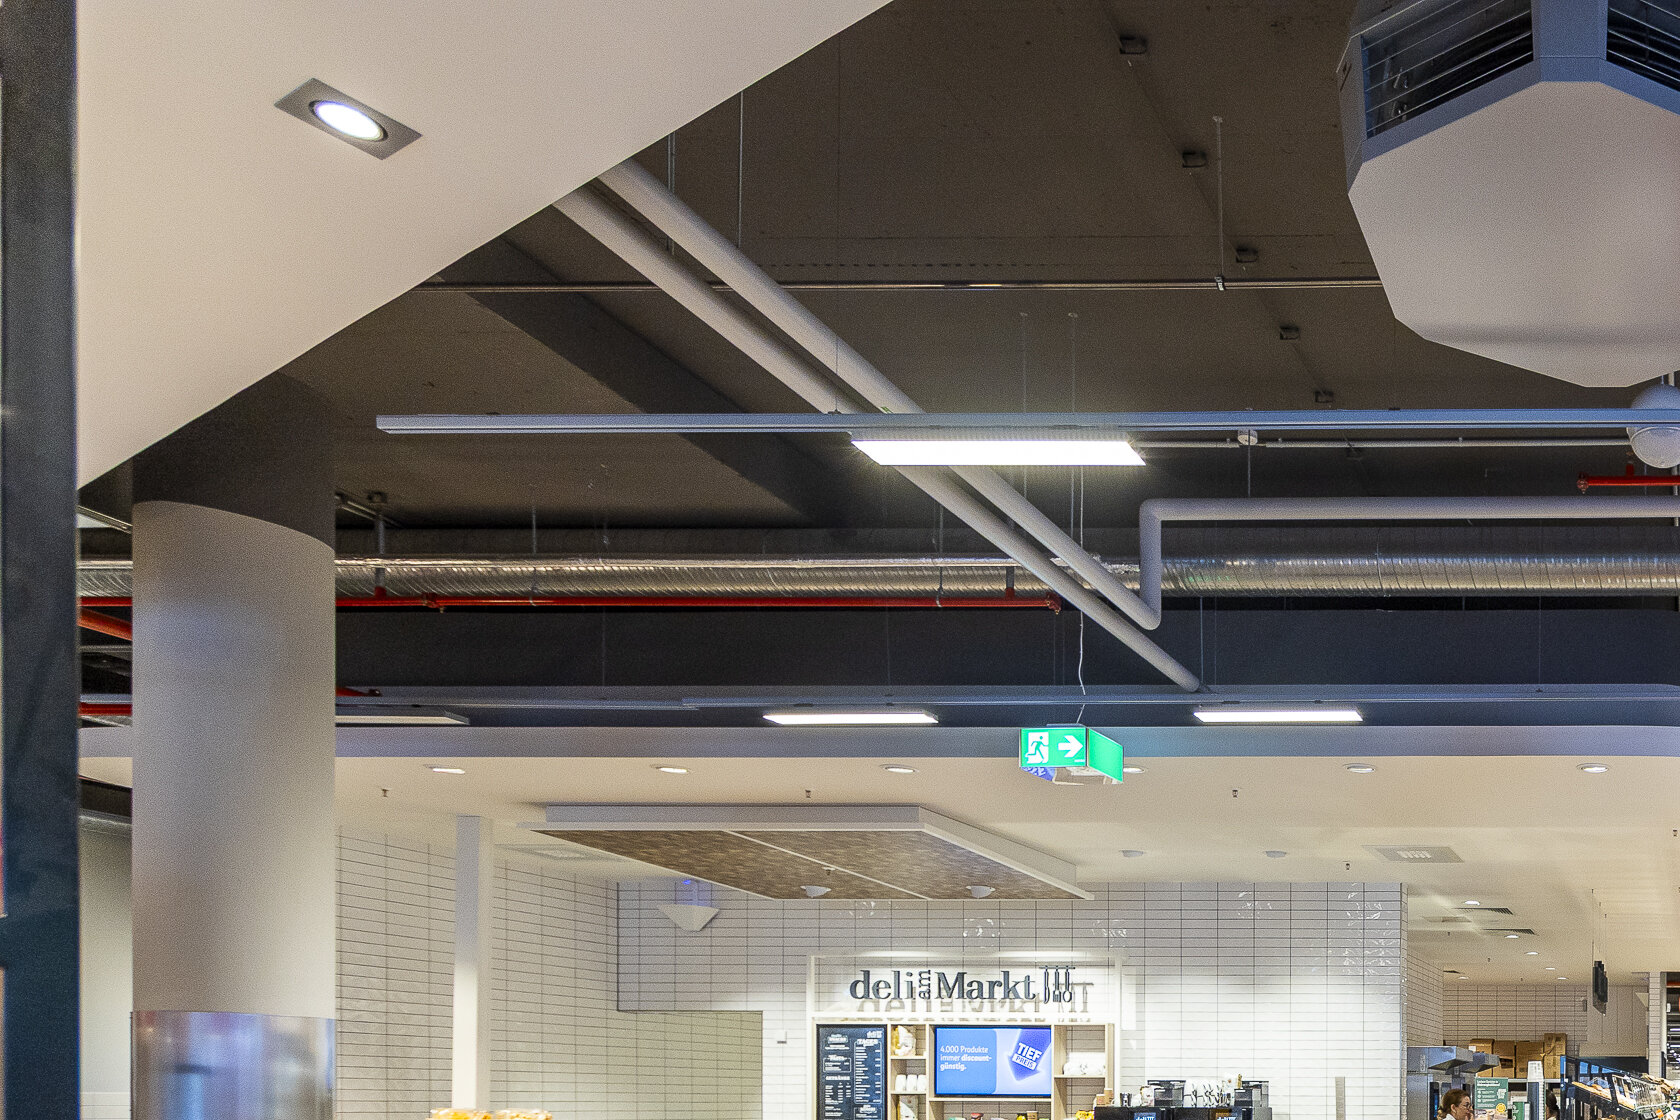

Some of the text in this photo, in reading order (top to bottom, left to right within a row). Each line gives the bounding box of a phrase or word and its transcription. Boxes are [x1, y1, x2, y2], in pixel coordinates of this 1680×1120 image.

[849, 969, 1036, 1000] deli am Markt
[960, 1045, 988, 1053] Produkte
[1017, 1042, 1042, 1061] TIEF
[940, 1062, 967, 1071] günstig.
[1015, 1055, 1034, 1068] PREIS
